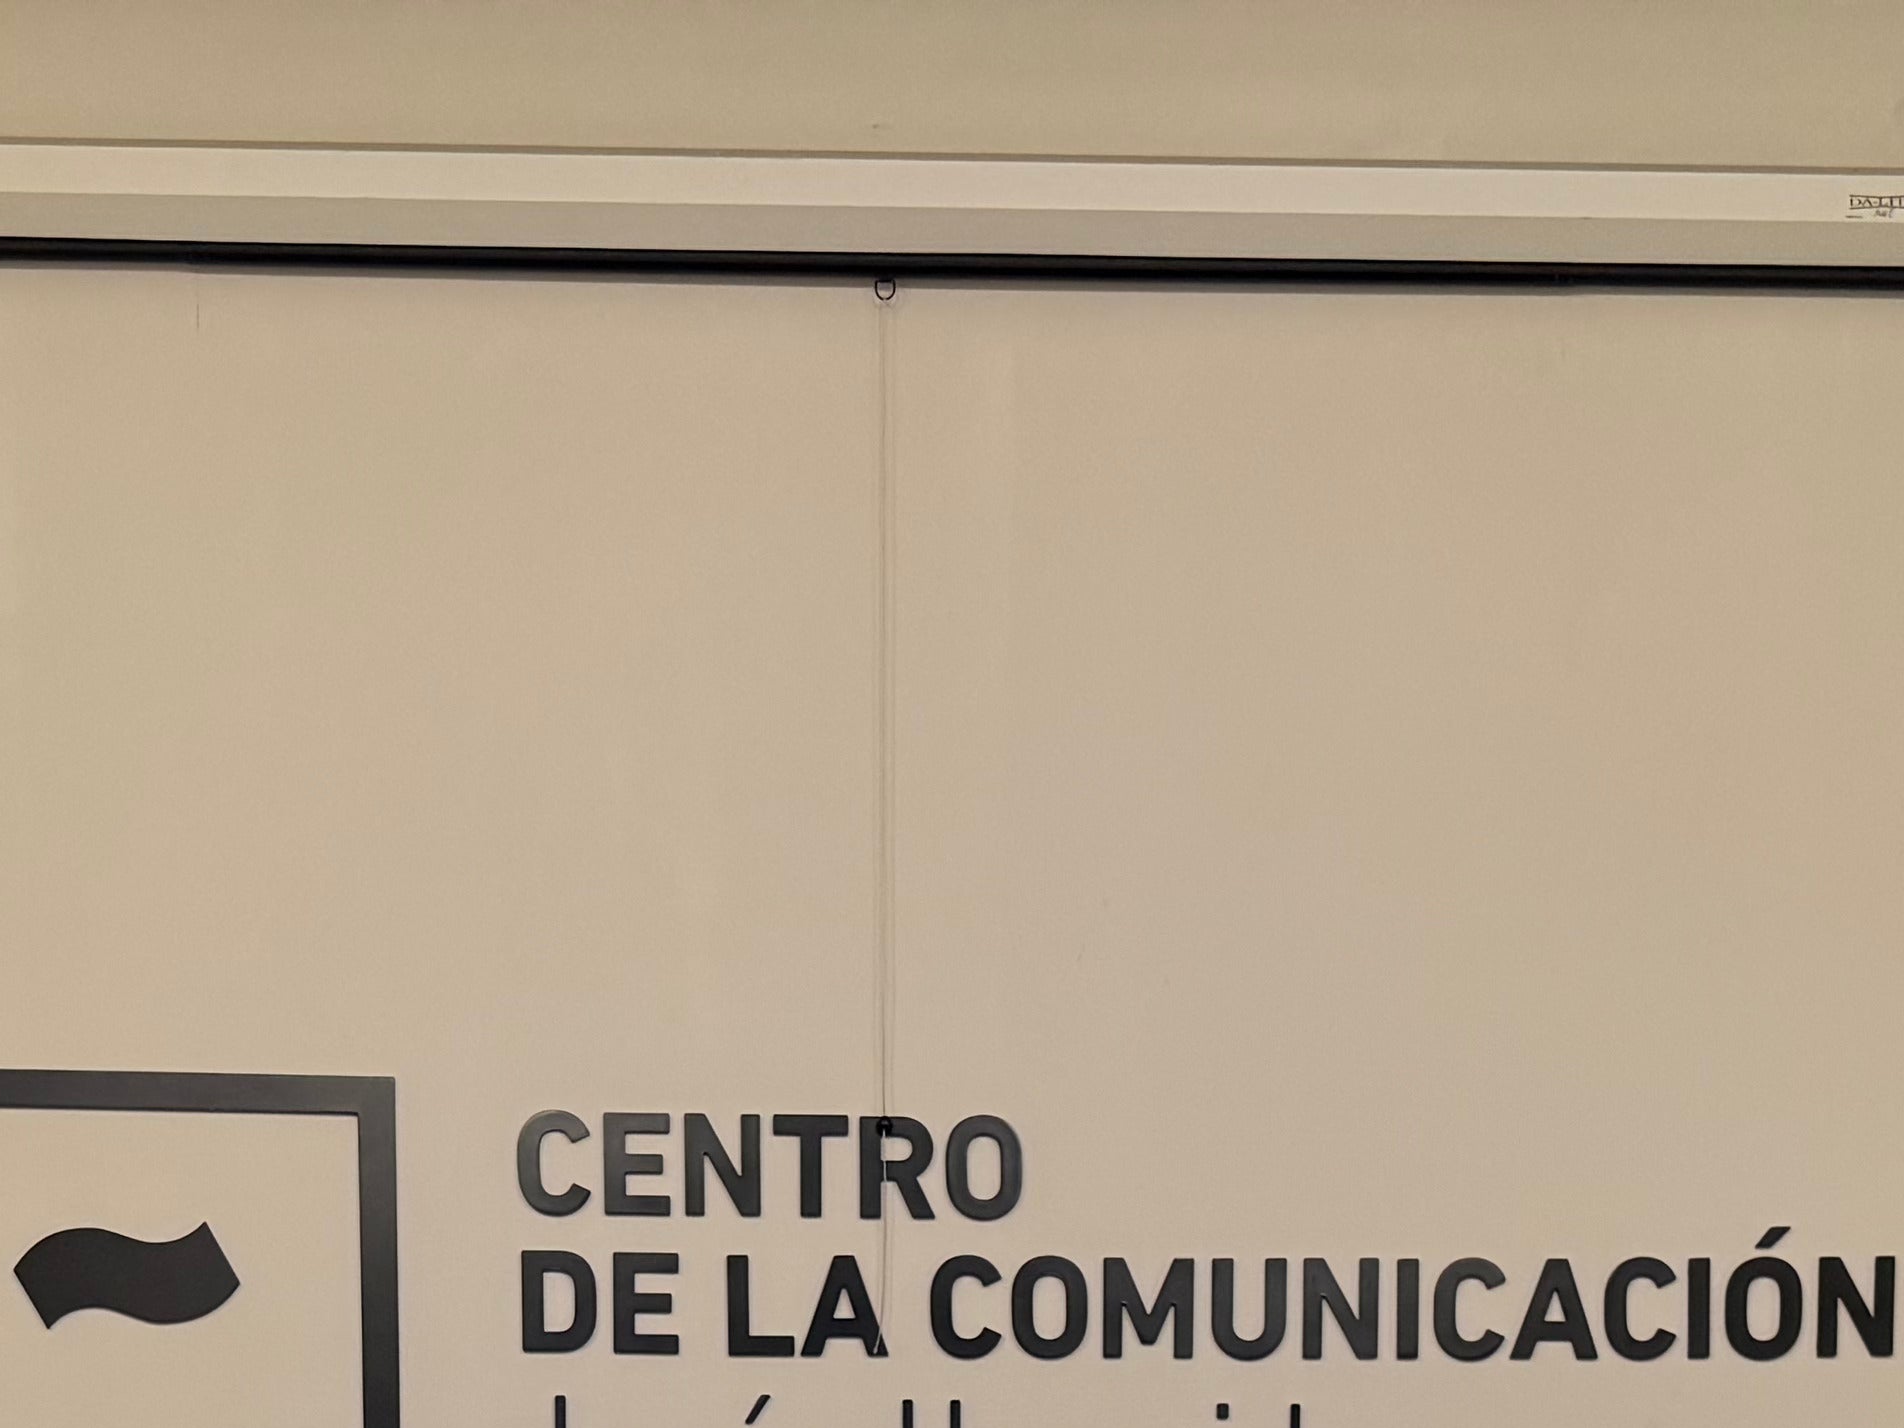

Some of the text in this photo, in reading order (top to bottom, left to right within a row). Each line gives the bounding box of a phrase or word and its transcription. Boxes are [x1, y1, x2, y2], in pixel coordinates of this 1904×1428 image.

[516, 1110, 1022, 1222] CENTRO
[520, 1226, 1896, 1363] DE LA COMUNICACIÓN
